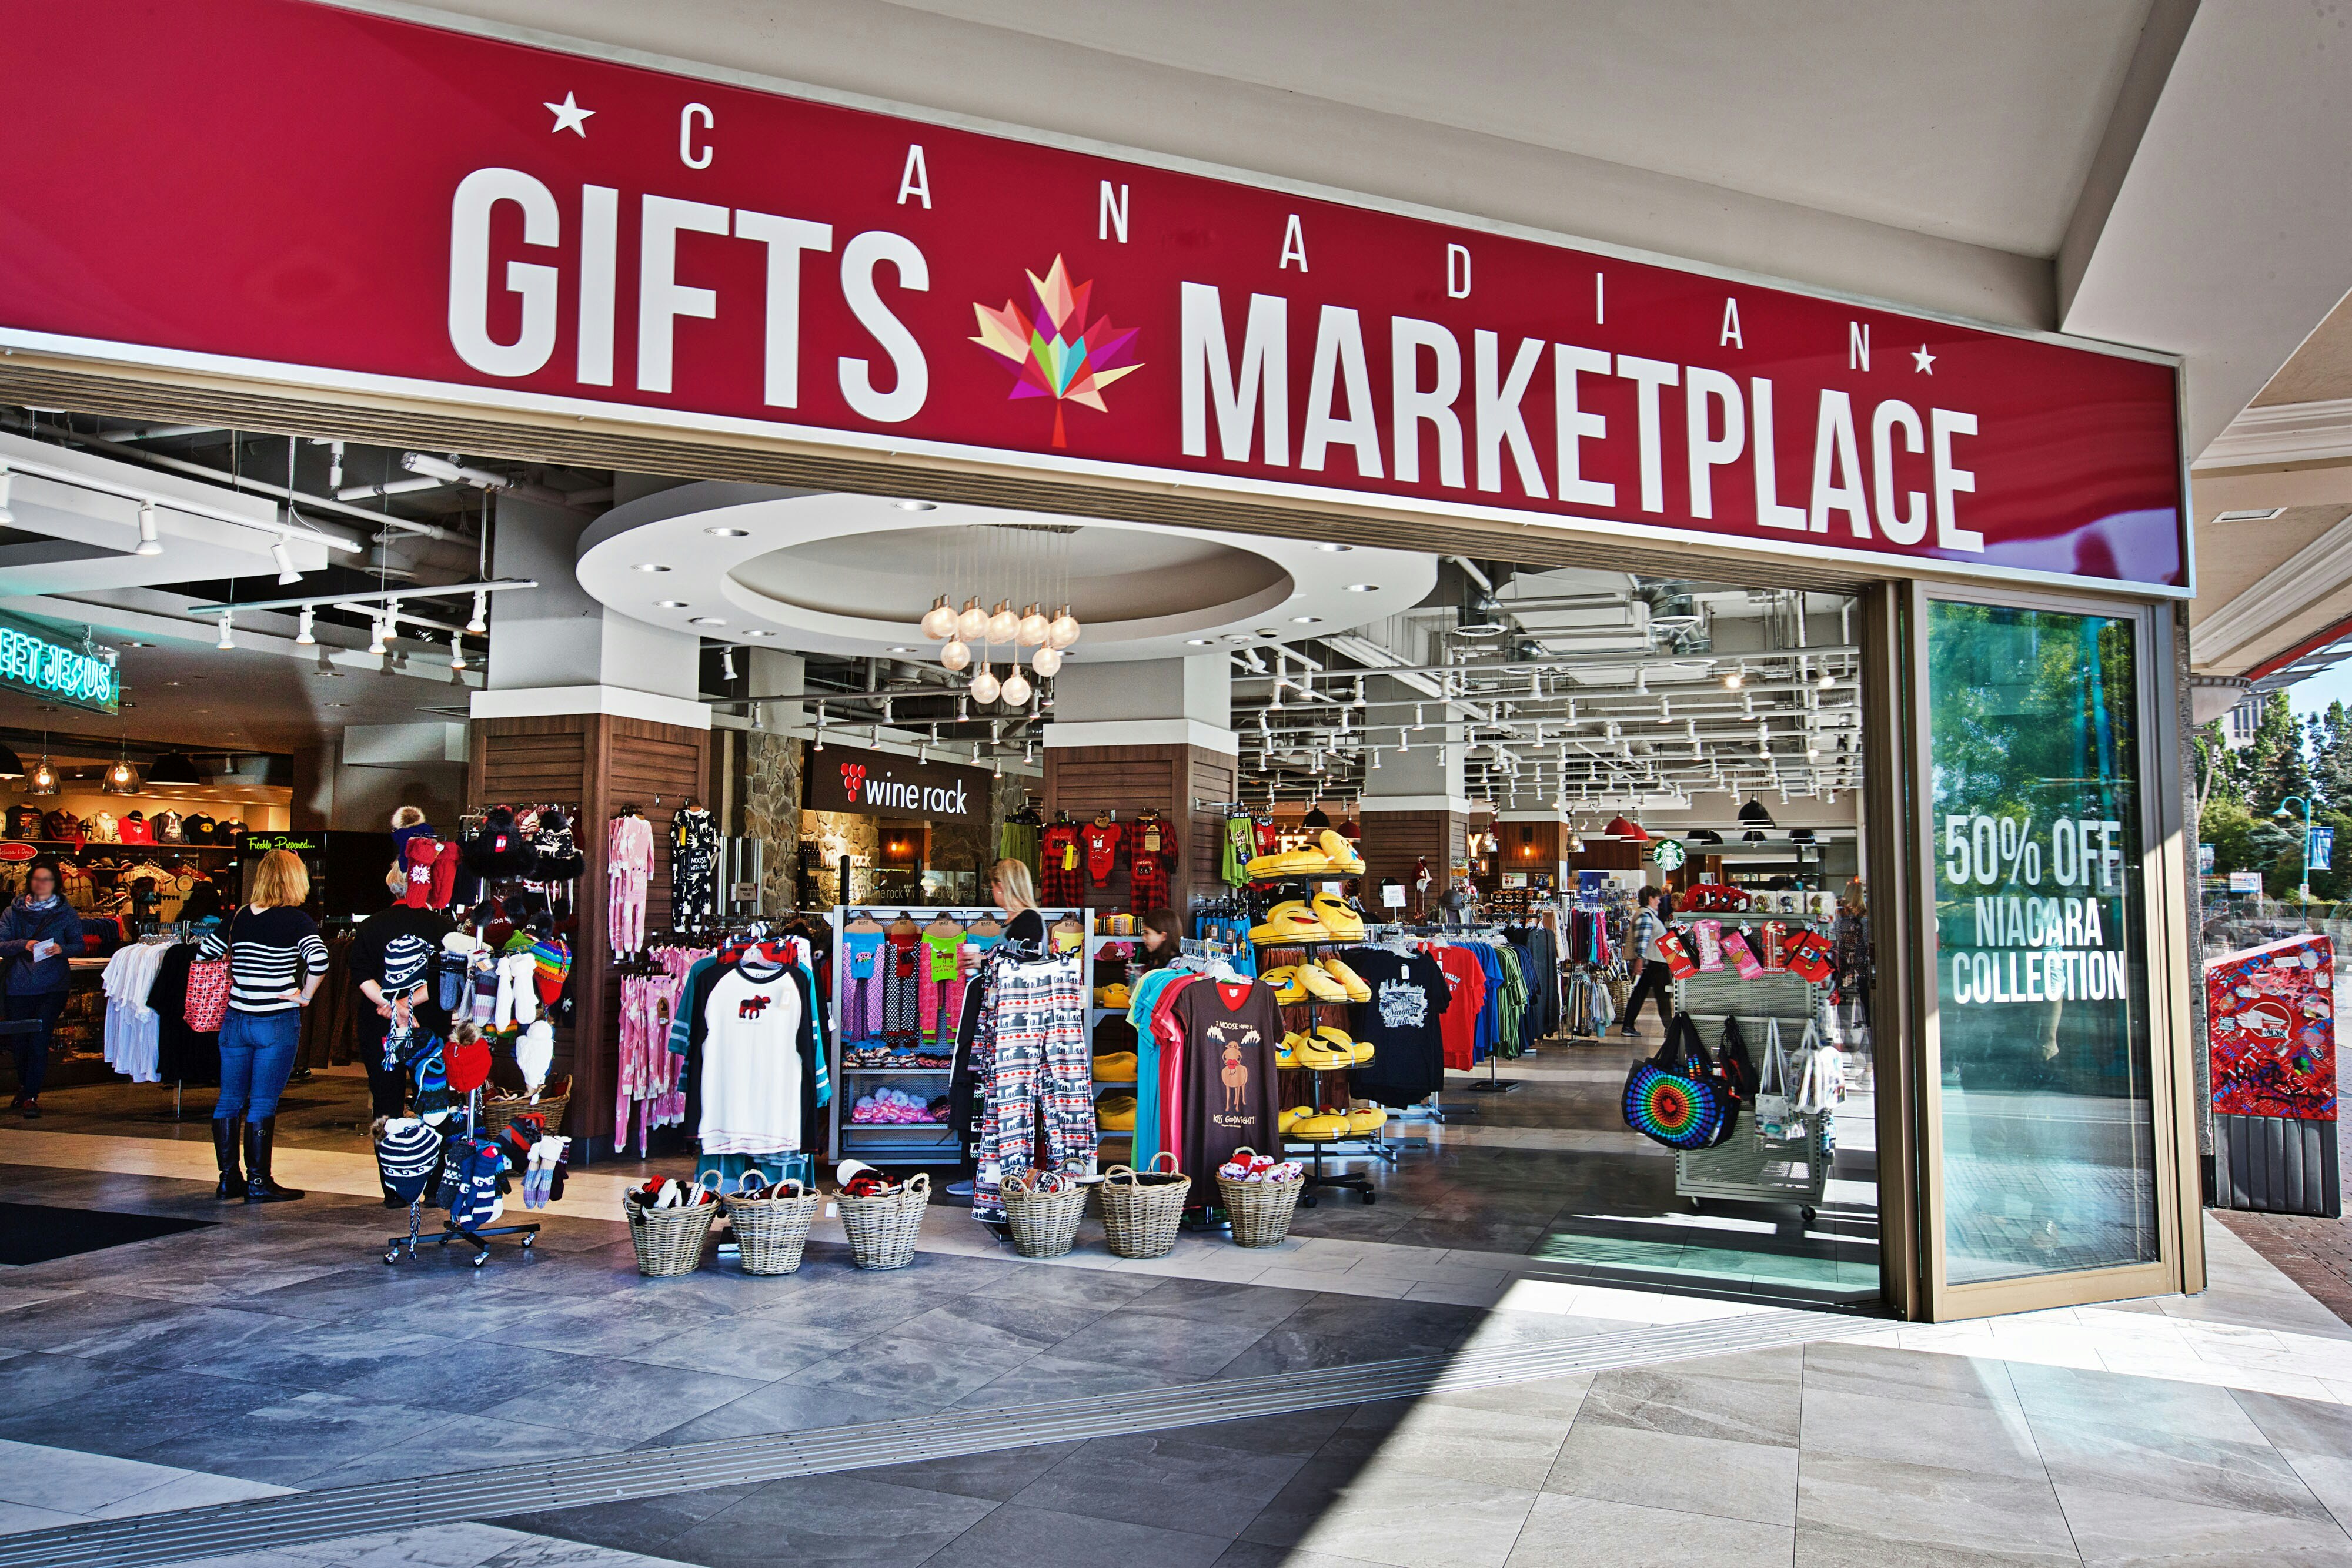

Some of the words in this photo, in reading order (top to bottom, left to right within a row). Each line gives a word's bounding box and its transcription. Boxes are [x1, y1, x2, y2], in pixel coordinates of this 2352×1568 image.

[679, 102, 1870, 373] CANADIAN
[447, 166, 930, 423] GIFTS
[1180, 280, 1985, 554] MARKETPLACE
[865, 771, 920, 810] wine
[923, 778, 968, 814] rack
[246, 837, 272, 852] Freshly
[274, 836, 315, 850] Prepared...
[1945, 814, 2041, 886] 50%
[2053, 818, 2121, 887] OFF
[886, 885, 903, 898] rack
[1975, 896, 2103, 947] NIAGARA
[1673, 964, 1691, 976] Canada
[1952, 950, 2126, 1004] COLLECTION
[1219, 1021, 1238, 1030] MOOSE
[1385, 1005, 1421, 1017] Niagara
[1390, 1017, 1410, 1025] Falls
[1213, 1114, 1223, 1124] KISS
